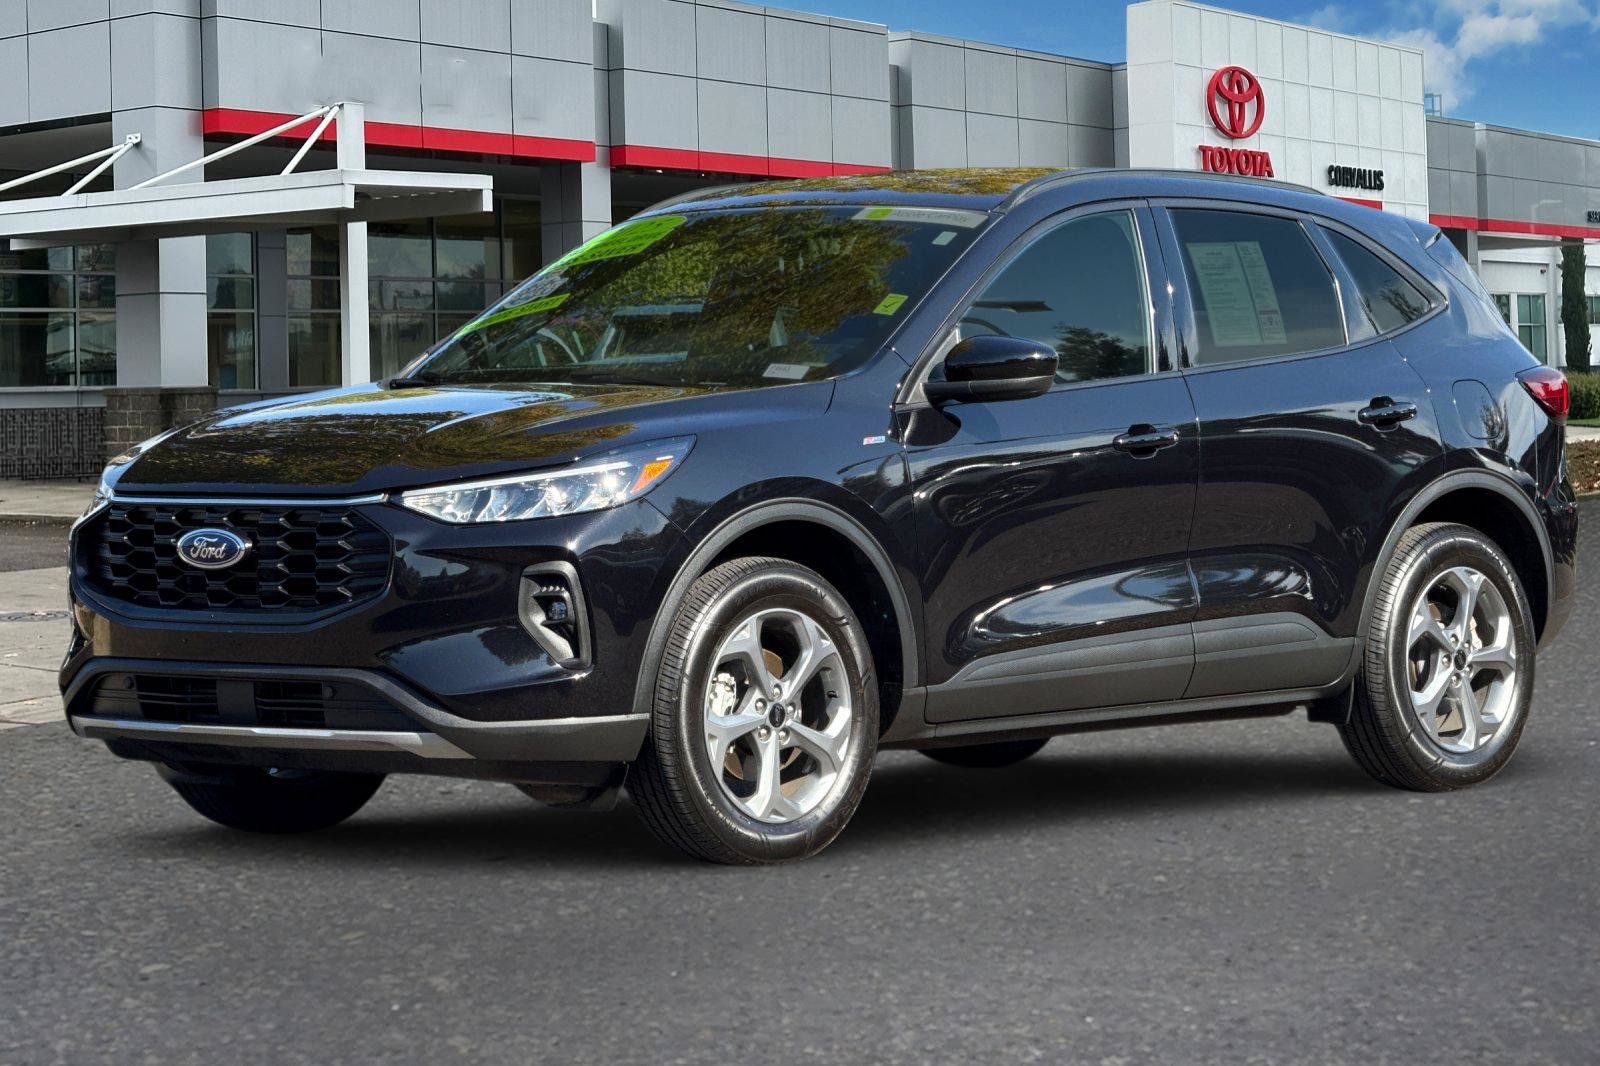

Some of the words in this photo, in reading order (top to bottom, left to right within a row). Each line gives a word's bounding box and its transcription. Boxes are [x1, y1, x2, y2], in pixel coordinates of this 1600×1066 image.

[1199, 145, 1274, 178] TOYOTA
[1328, 165, 1384, 190] CORVALLIS
[190, 536, 227, 559] Ford
